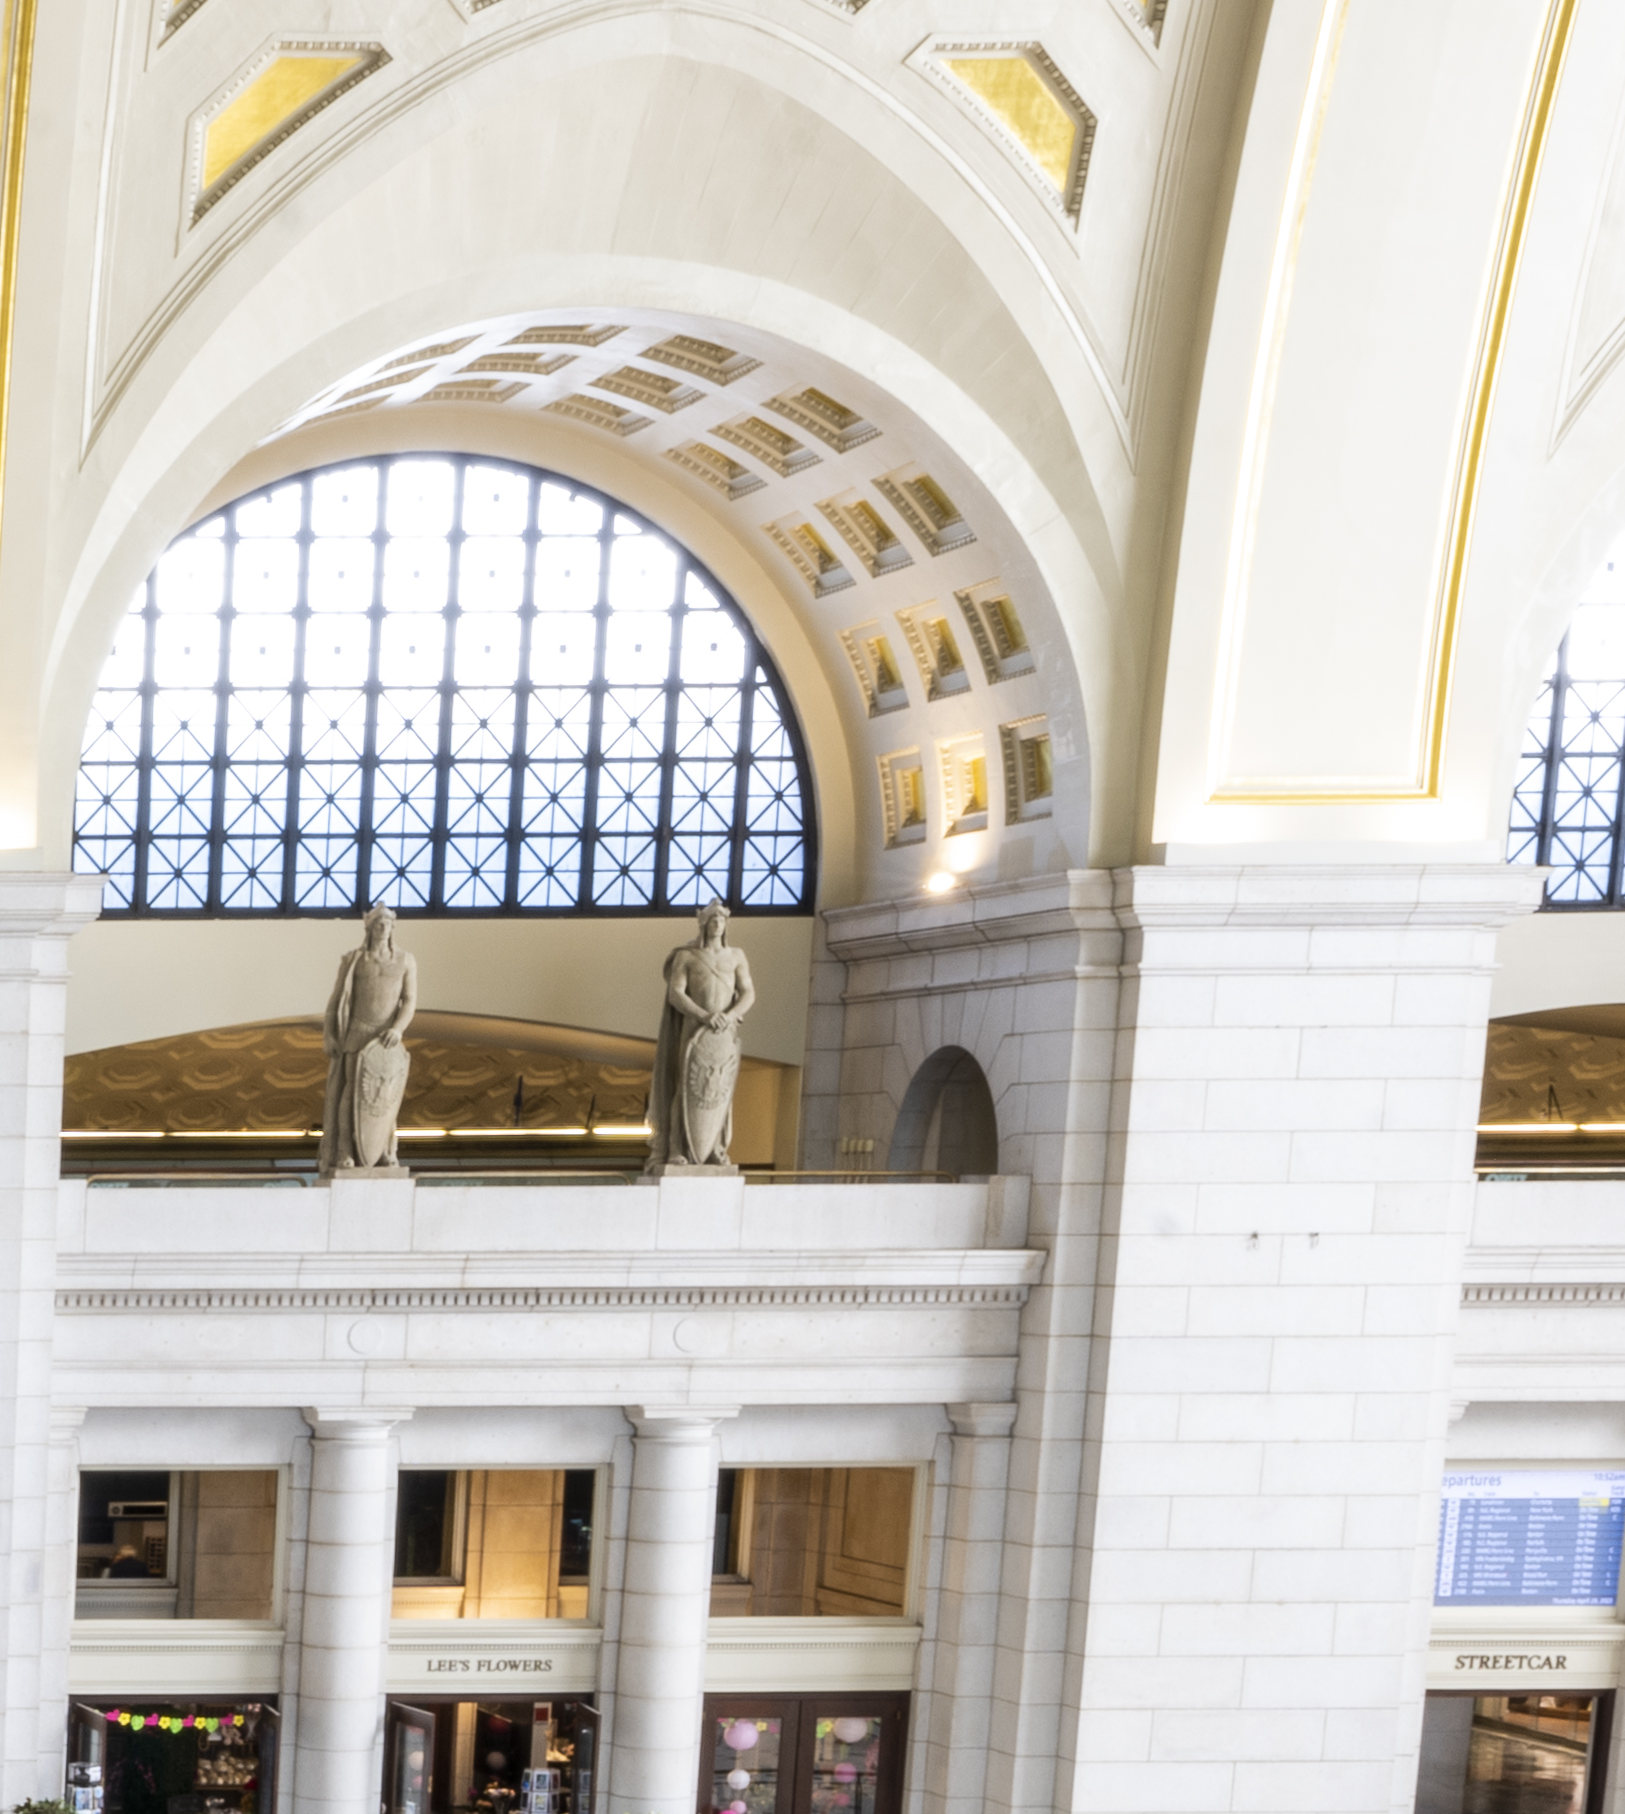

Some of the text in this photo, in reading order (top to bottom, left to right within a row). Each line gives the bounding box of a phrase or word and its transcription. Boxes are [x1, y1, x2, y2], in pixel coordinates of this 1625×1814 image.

[1442, 1475, 1501, 1489] epartures
[426, 1658, 553, 1673] LEE'S FLOWERS
[1453, 1653, 1568, 1671] STREETCAR
